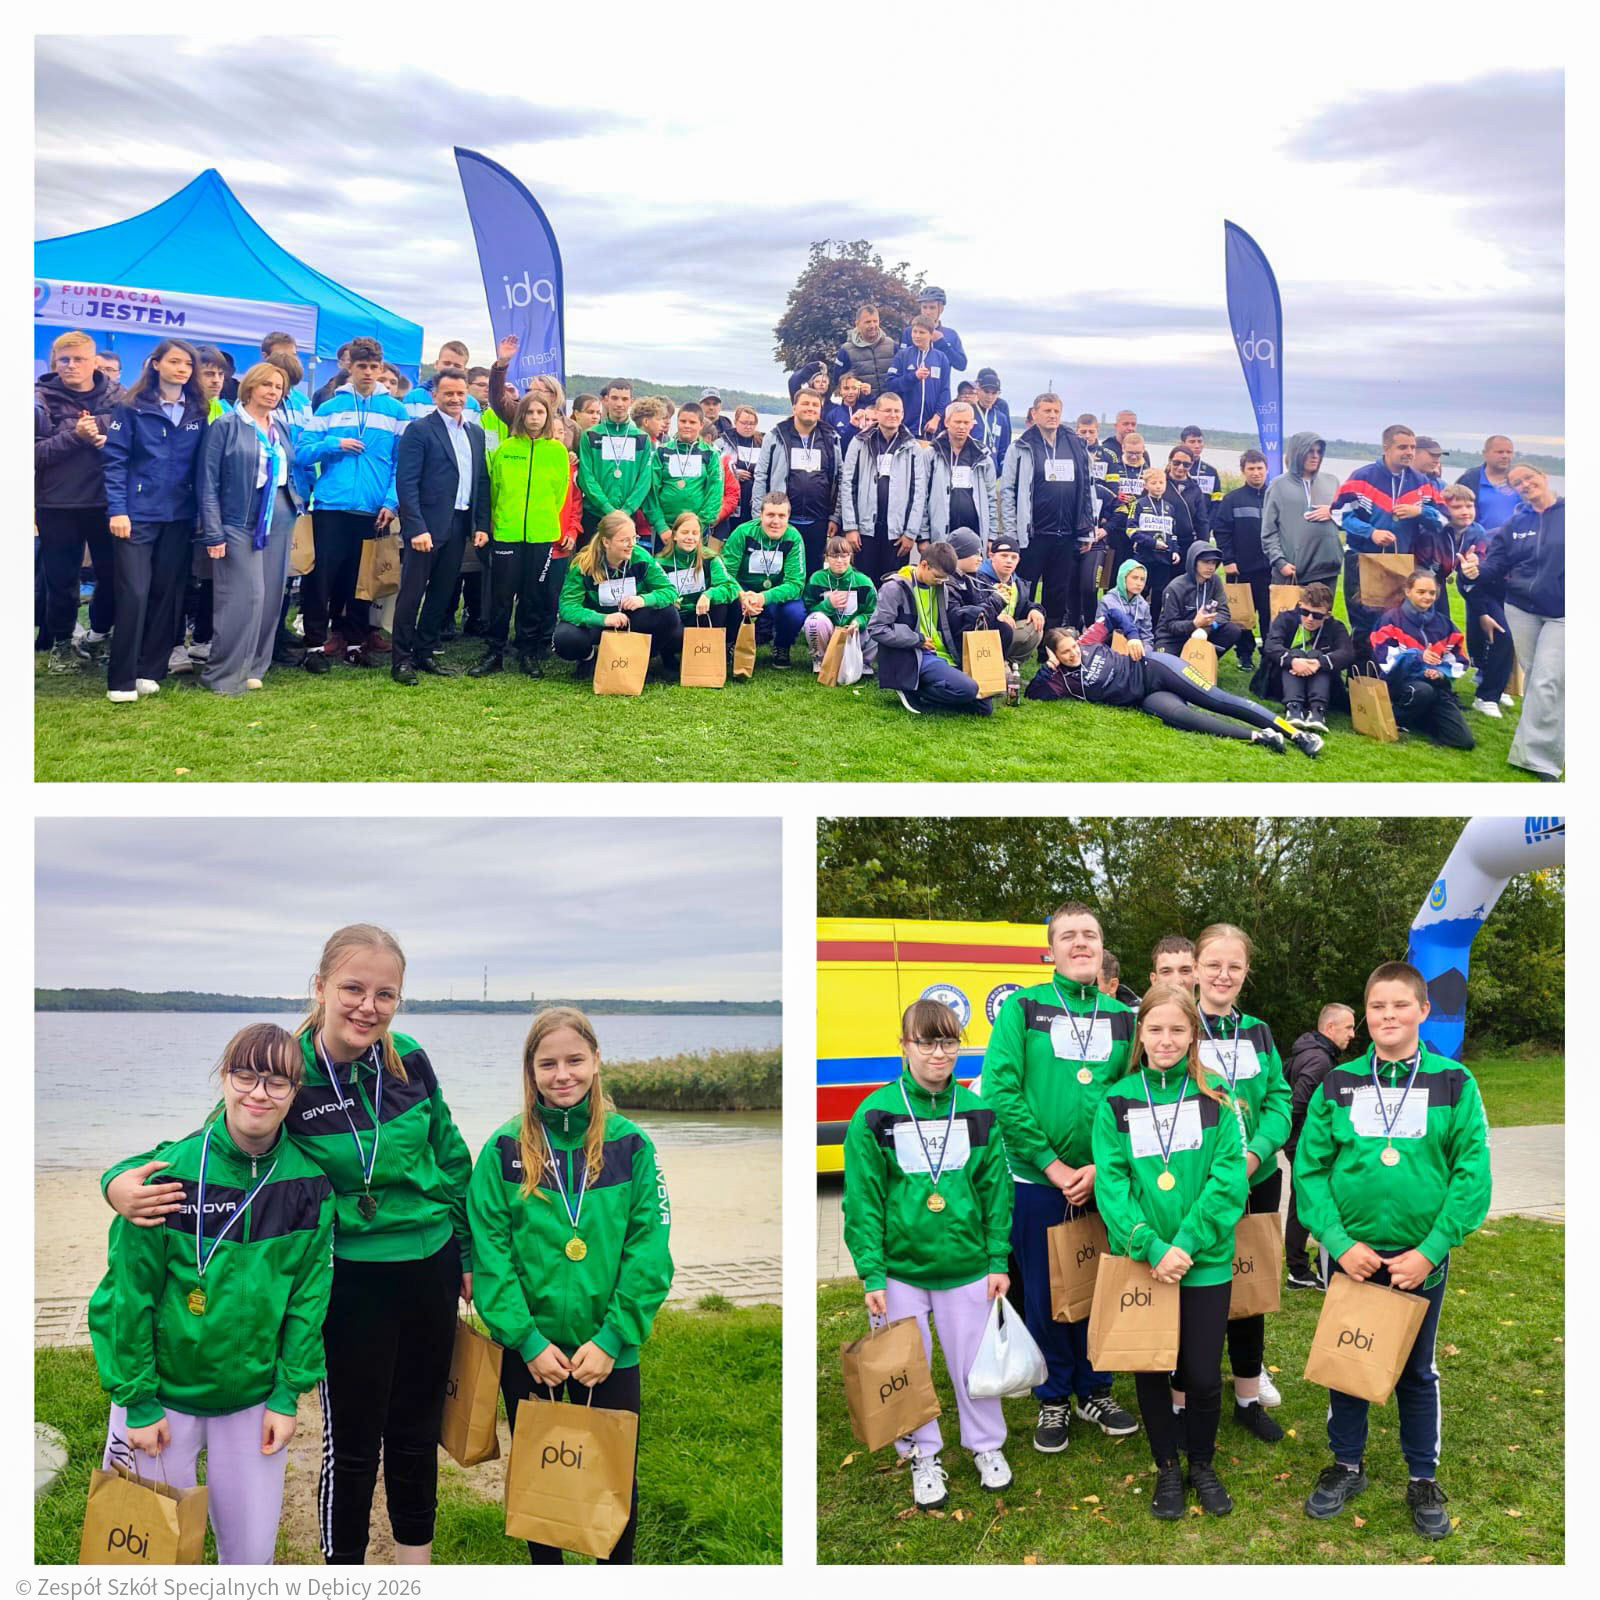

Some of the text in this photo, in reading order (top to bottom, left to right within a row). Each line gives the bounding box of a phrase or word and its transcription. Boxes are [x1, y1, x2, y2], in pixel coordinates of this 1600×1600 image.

[61, 285, 162, 305] FUNDACJA
[61, 300, 186, 327] tuJESTEM
[185, 422, 199, 432] pbi
[694, 642, 712, 657] pbi
[976, 646, 992, 661] pbi
[1188, 649, 1205, 662] pbi
[611, 657, 629, 671] pbi
[302, 1098, 355, 1121] GIVOVA
[921, 1136, 946, 1150] 042
[654, 1152, 670, 1225] GIVOVA
[178, 1202, 236, 1214] GIVOVA
[1076, 1241, 1097, 1268] pbi
[1120, 1287, 1153, 1312] pbi
[1337, 1327, 1375, 1352] pbi
[879, 1369, 910, 1404] pbi
[541, 1440, 584, 1470] pbi
[108, 1524, 150, 1559] pbi
